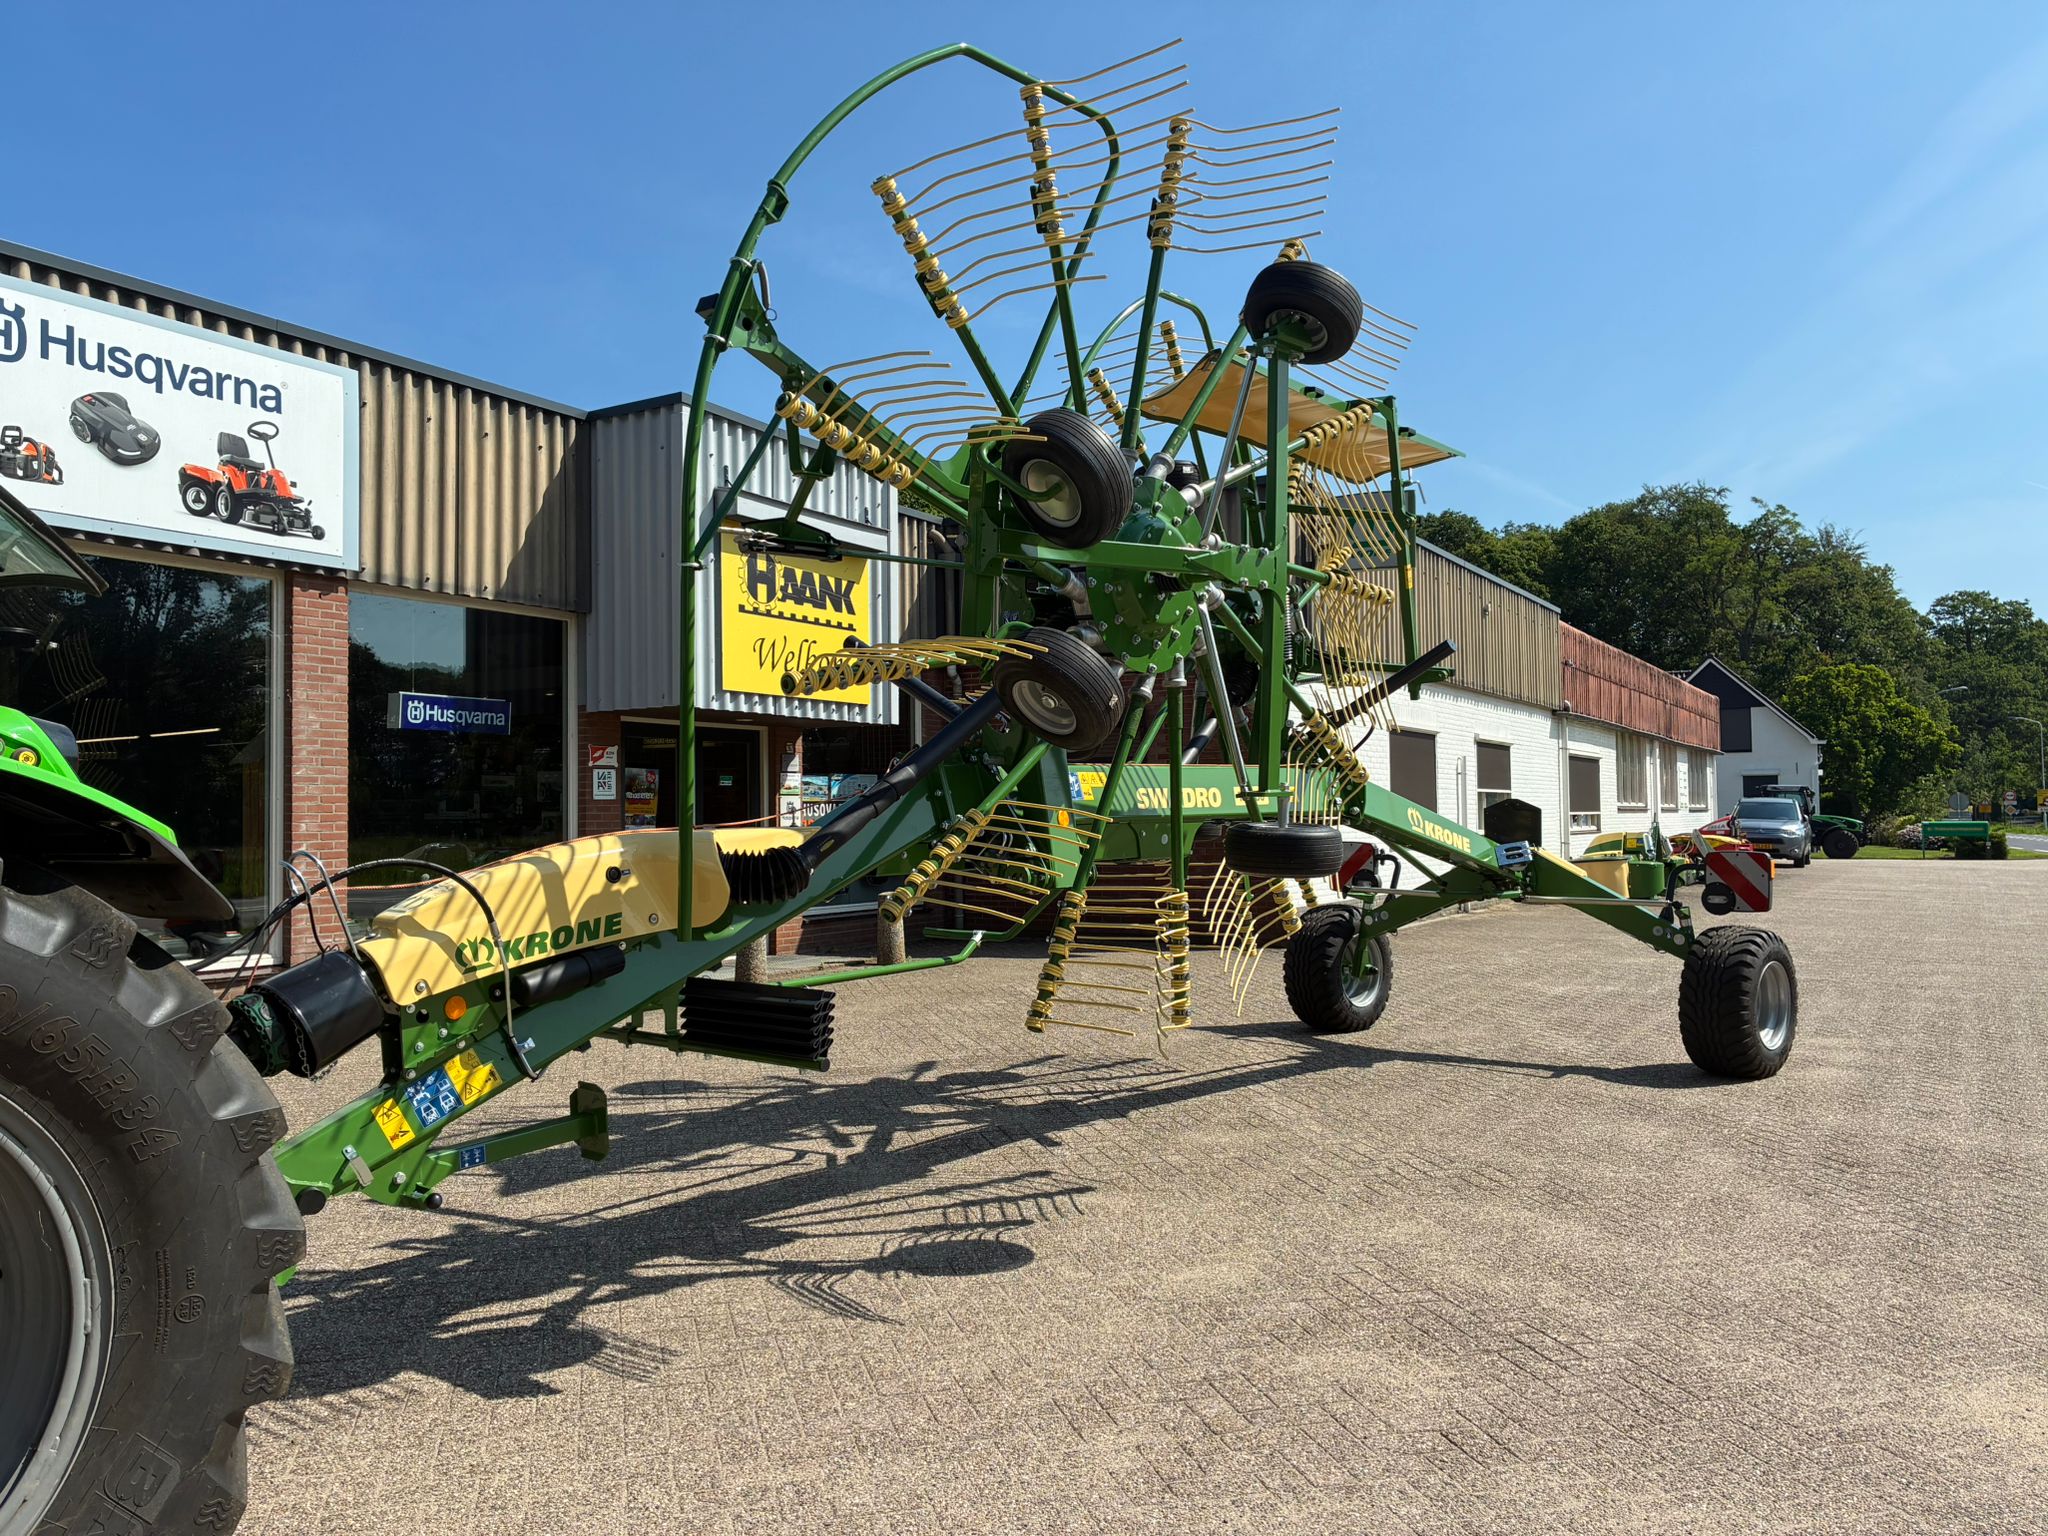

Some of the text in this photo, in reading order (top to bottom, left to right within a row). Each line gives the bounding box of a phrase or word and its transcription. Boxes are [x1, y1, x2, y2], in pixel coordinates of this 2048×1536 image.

[40, 318, 283, 414] Husqvarna
[746, 553, 857, 616] HAANK
[425, 703, 506, 727] Husqvarna
[1136, 787, 1222, 810] SWDRO
[1424, 820, 1473, 854] KRONE
[503, 911, 623, 963] KRONE
